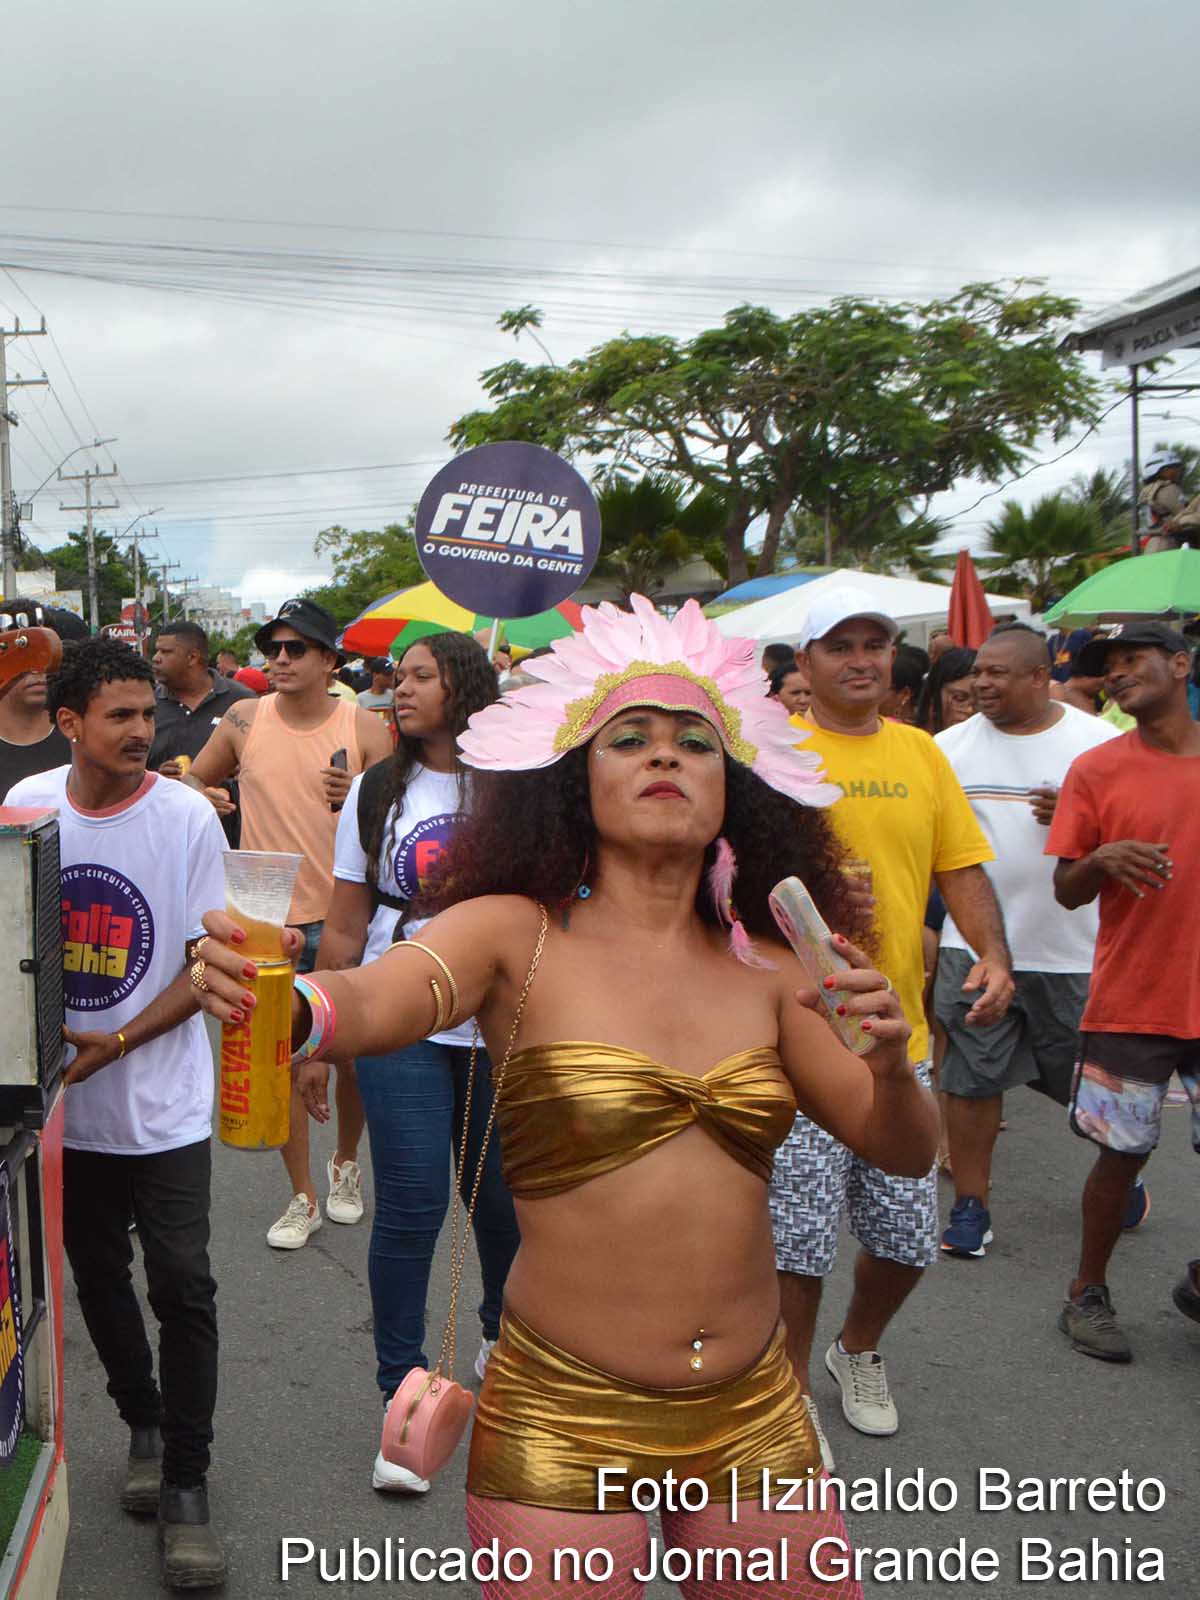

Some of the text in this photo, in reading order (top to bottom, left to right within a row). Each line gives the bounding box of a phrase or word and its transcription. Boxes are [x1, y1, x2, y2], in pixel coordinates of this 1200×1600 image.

[458, 482, 568, 508] PREFEITURA DE
[429, 492, 584, 555] FEIRA
[423, 543, 584, 576] O GOVERNO DA GENTE
